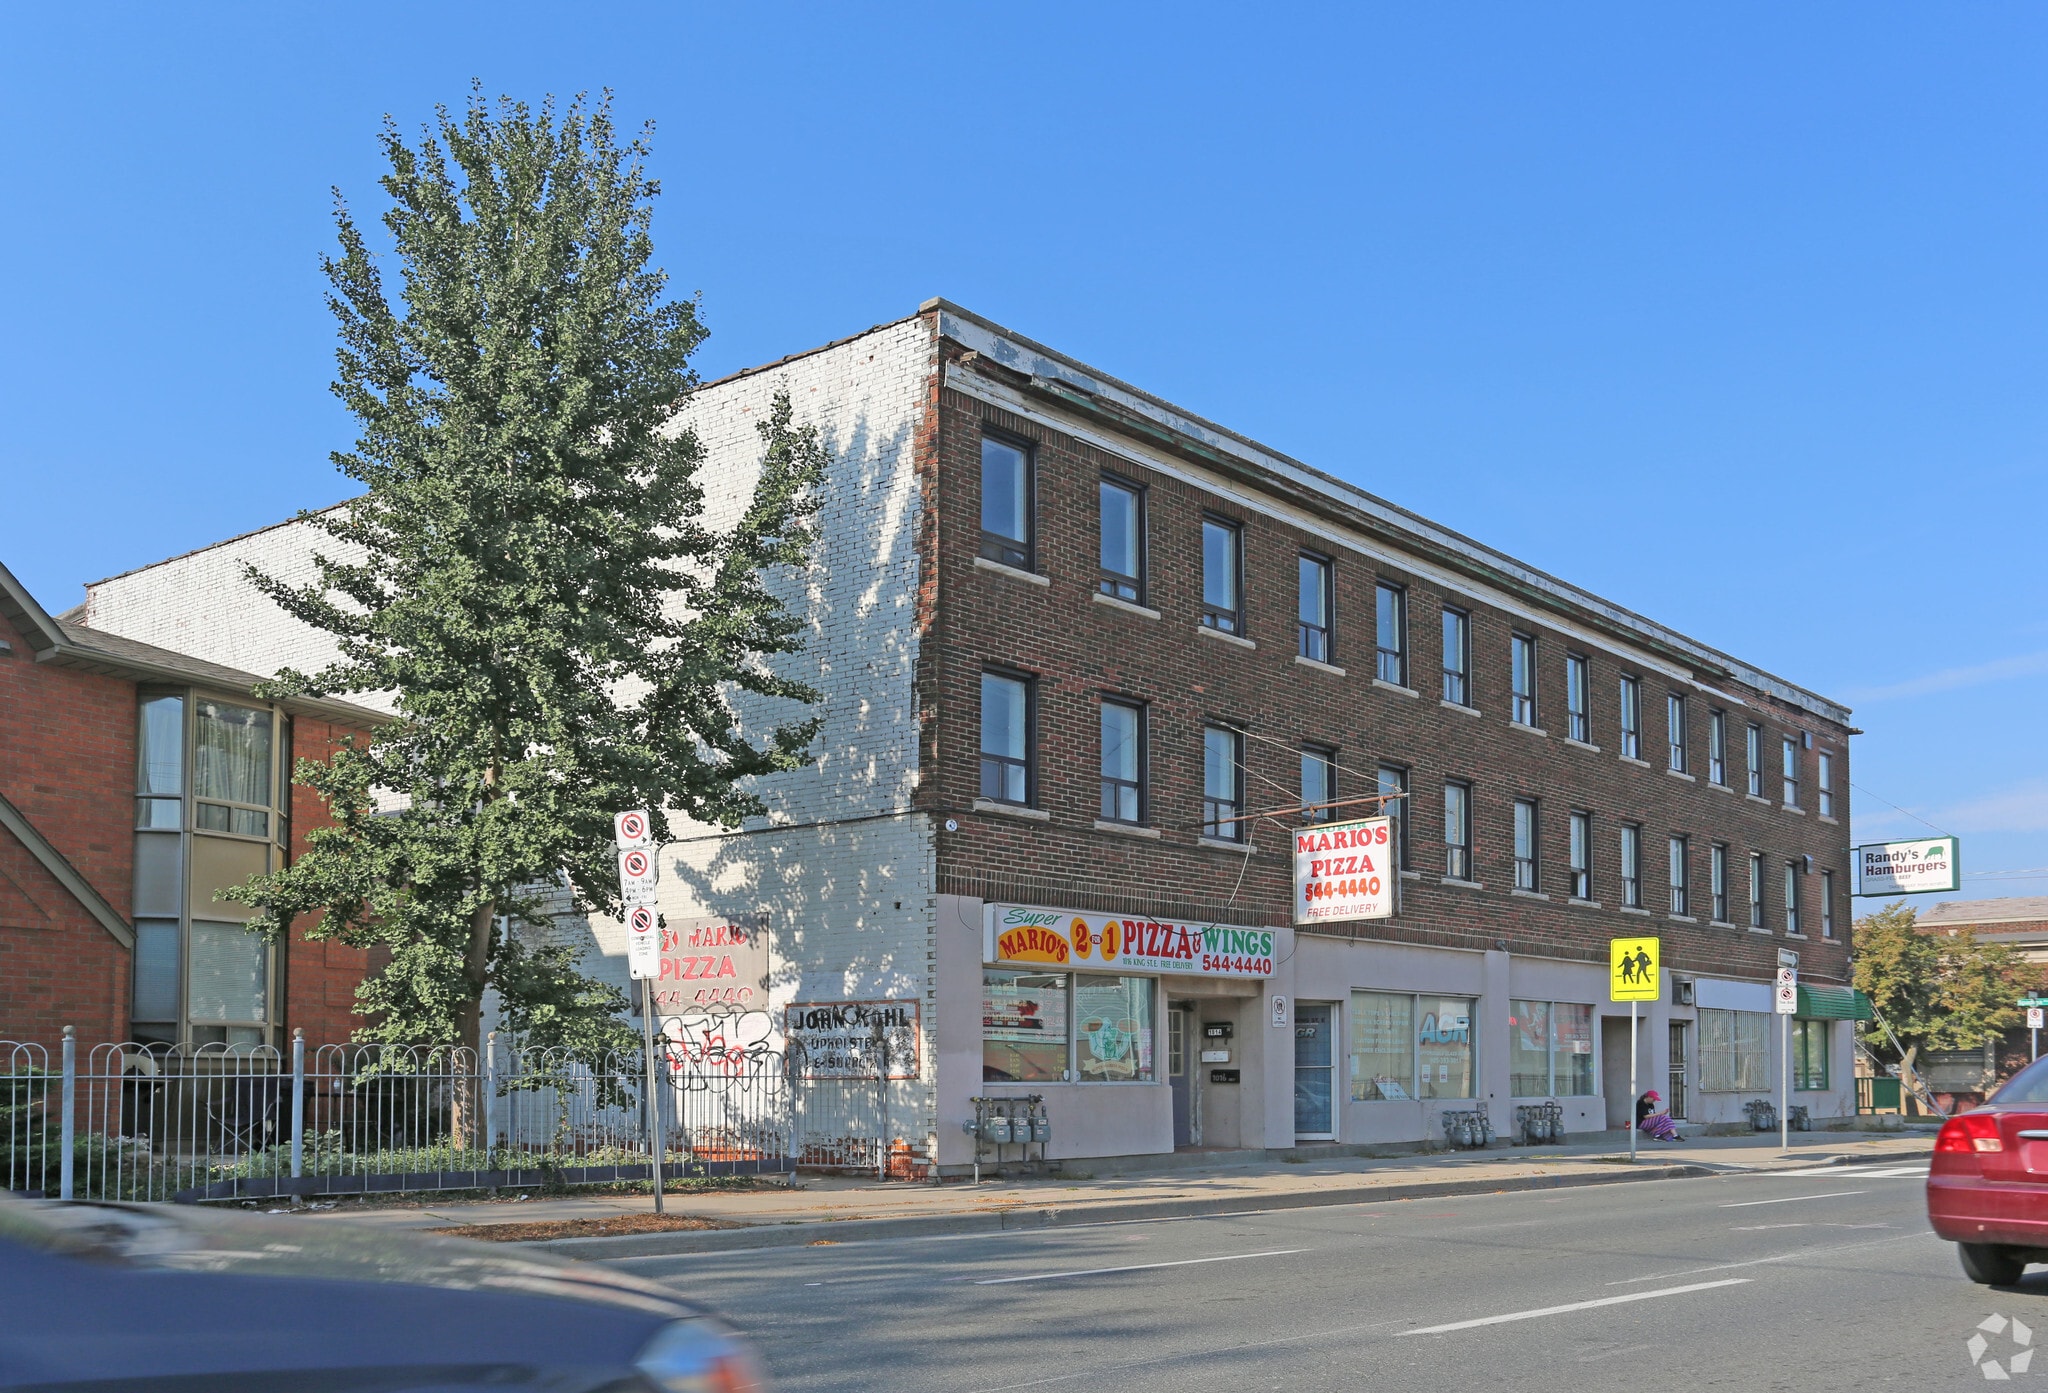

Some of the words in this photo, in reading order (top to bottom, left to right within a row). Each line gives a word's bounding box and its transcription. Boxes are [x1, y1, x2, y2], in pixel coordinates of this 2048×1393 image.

[1297, 826, 1387, 853] MARIO'S
[1310, 854, 1375, 878] PIZZA
[1865, 850, 1919, 863] Randy's
[1865, 861, 1947, 876] Hamburgers
[1305, 876, 1381, 902] 544-4440
[1003, 908, 1062, 926] Super
[1307, 906, 1332, 918] FREE
[1333, 903, 1378, 916] DELIVERY
[1000, 928, 1068, 962] MARIO'S
[1075, 923, 1088, 953] 2
[1107, 927, 1116, 954] 1
[1122, 920, 1193, 960] PIZZA
[1201, 926, 1272, 956] WINGS
[659, 955, 736, 981] PIZZA
[1419, 1012, 1470, 1046] AGR
